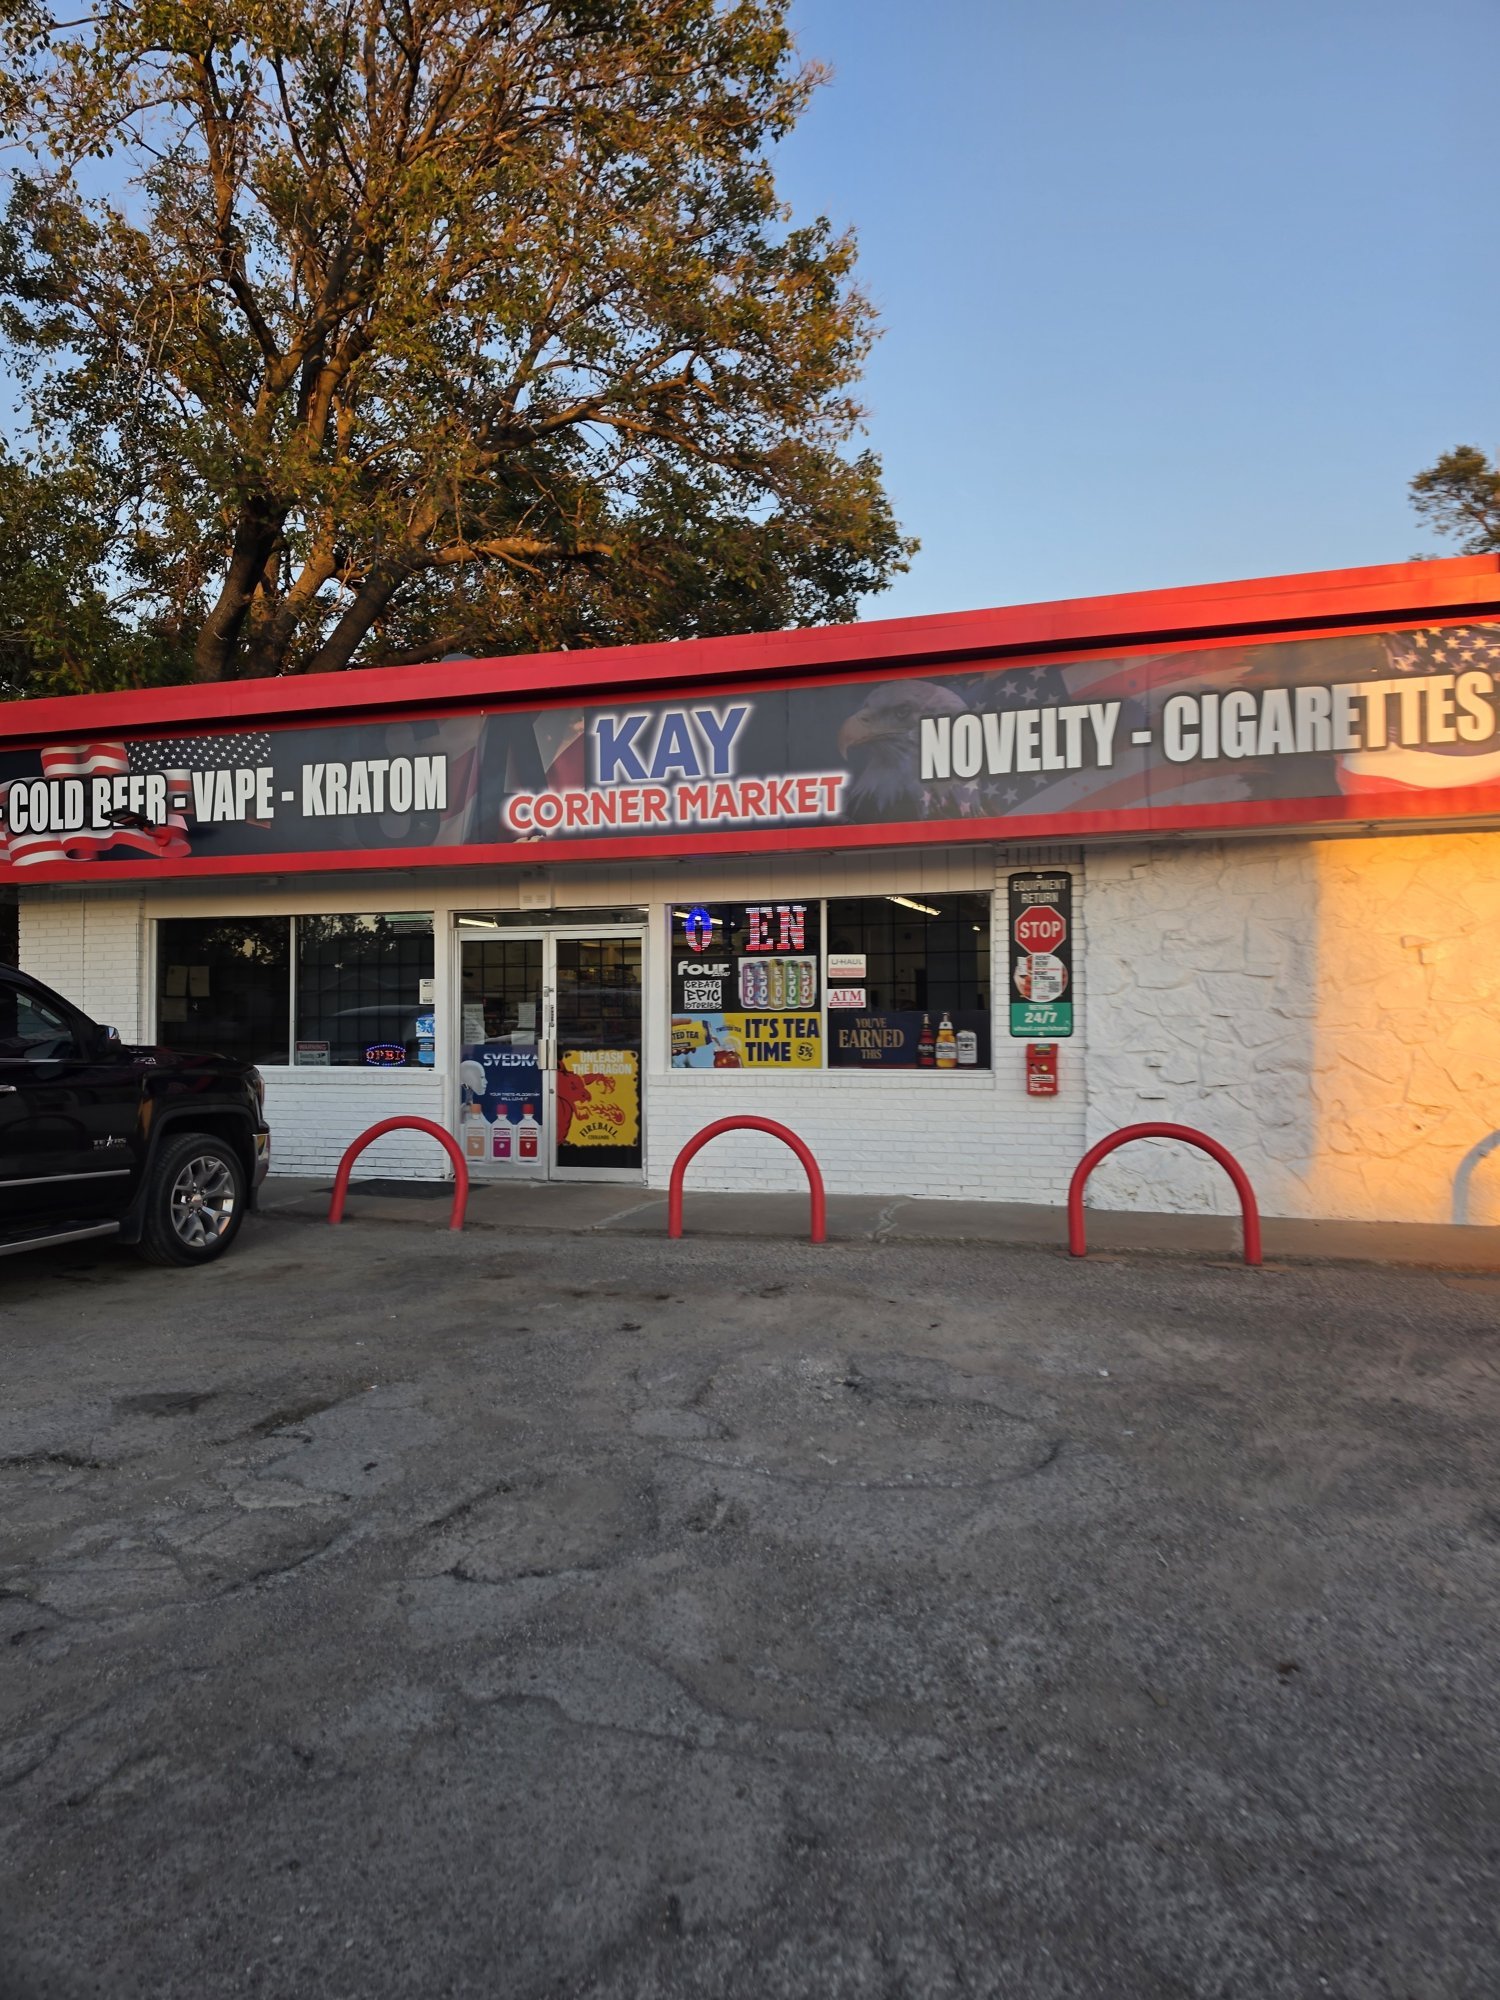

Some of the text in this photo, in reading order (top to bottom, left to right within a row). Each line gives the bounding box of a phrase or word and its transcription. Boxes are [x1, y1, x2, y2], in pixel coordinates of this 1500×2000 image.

[920, 701, 1121, 780] NOVELTY
[1163, 671, 1496, 762] CIGARETTES
[596, 706, 748, 782] KAY
[9, 780, 84, 834] COLD
[92, 774, 166, 828] BEER
[192, 766, 274, 823] VAPE
[302, 755, 447, 817] KRATOM
[508, 776, 843, 830] CORNER MARKET
[1013, 879, 1067, 891] EQUIPMENT
[1021, 892, 1058, 903] RETURN
[1020, 921, 1061, 939] STOP
[685, 980, 721, 989] CREATE
[685, 989, 720, 1002] EPIC
[831, 990, 862, 1001] ATM
[685, 1001, 722, 1009] STORIES
[855, 1018, 887, 1029] YOU'VE
[1024, 1011, 1058, 1024] 24/7
[686, 1030, 699, 1039] TEA
[745, 1018, 820, 1038] IT'S TEA
[838, 1029, 905, 1048] EARNED
[580, 1051, 624, 1063] UNLEASH
[745, 1042, 791, 1062] TIME
[798, 1045, 813, 1058] 5%
[860, 1049, 882, 1059] THIS
[483, 1053, 539, 1067] SVEDKA
[572, 1063, 632, 1074] THE DRAGON
[579, 1122, 619, 1137] FIREBALL
